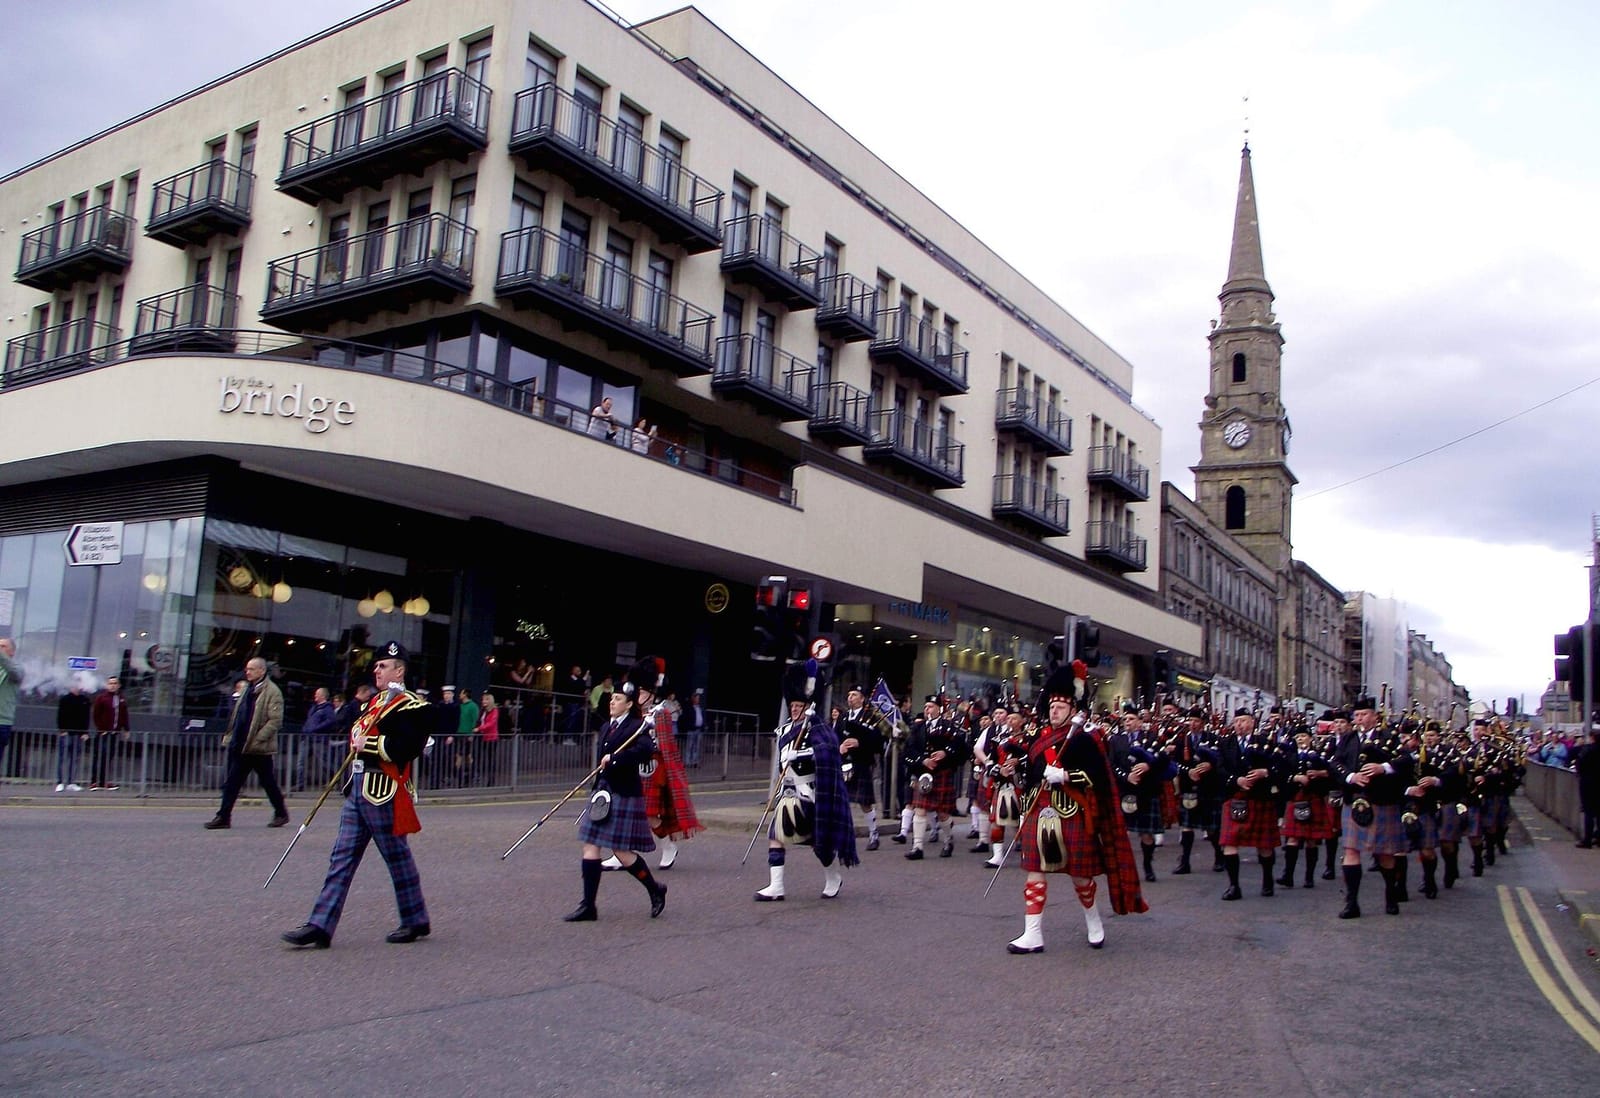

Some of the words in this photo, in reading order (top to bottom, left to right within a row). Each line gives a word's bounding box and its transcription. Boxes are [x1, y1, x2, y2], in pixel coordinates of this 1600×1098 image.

[230, 376, 245, 388] by
[247, 376, 265, 388] the
[218, 376, 356, 433] bridge
[888, 601, 951, 624] PRIMARK
